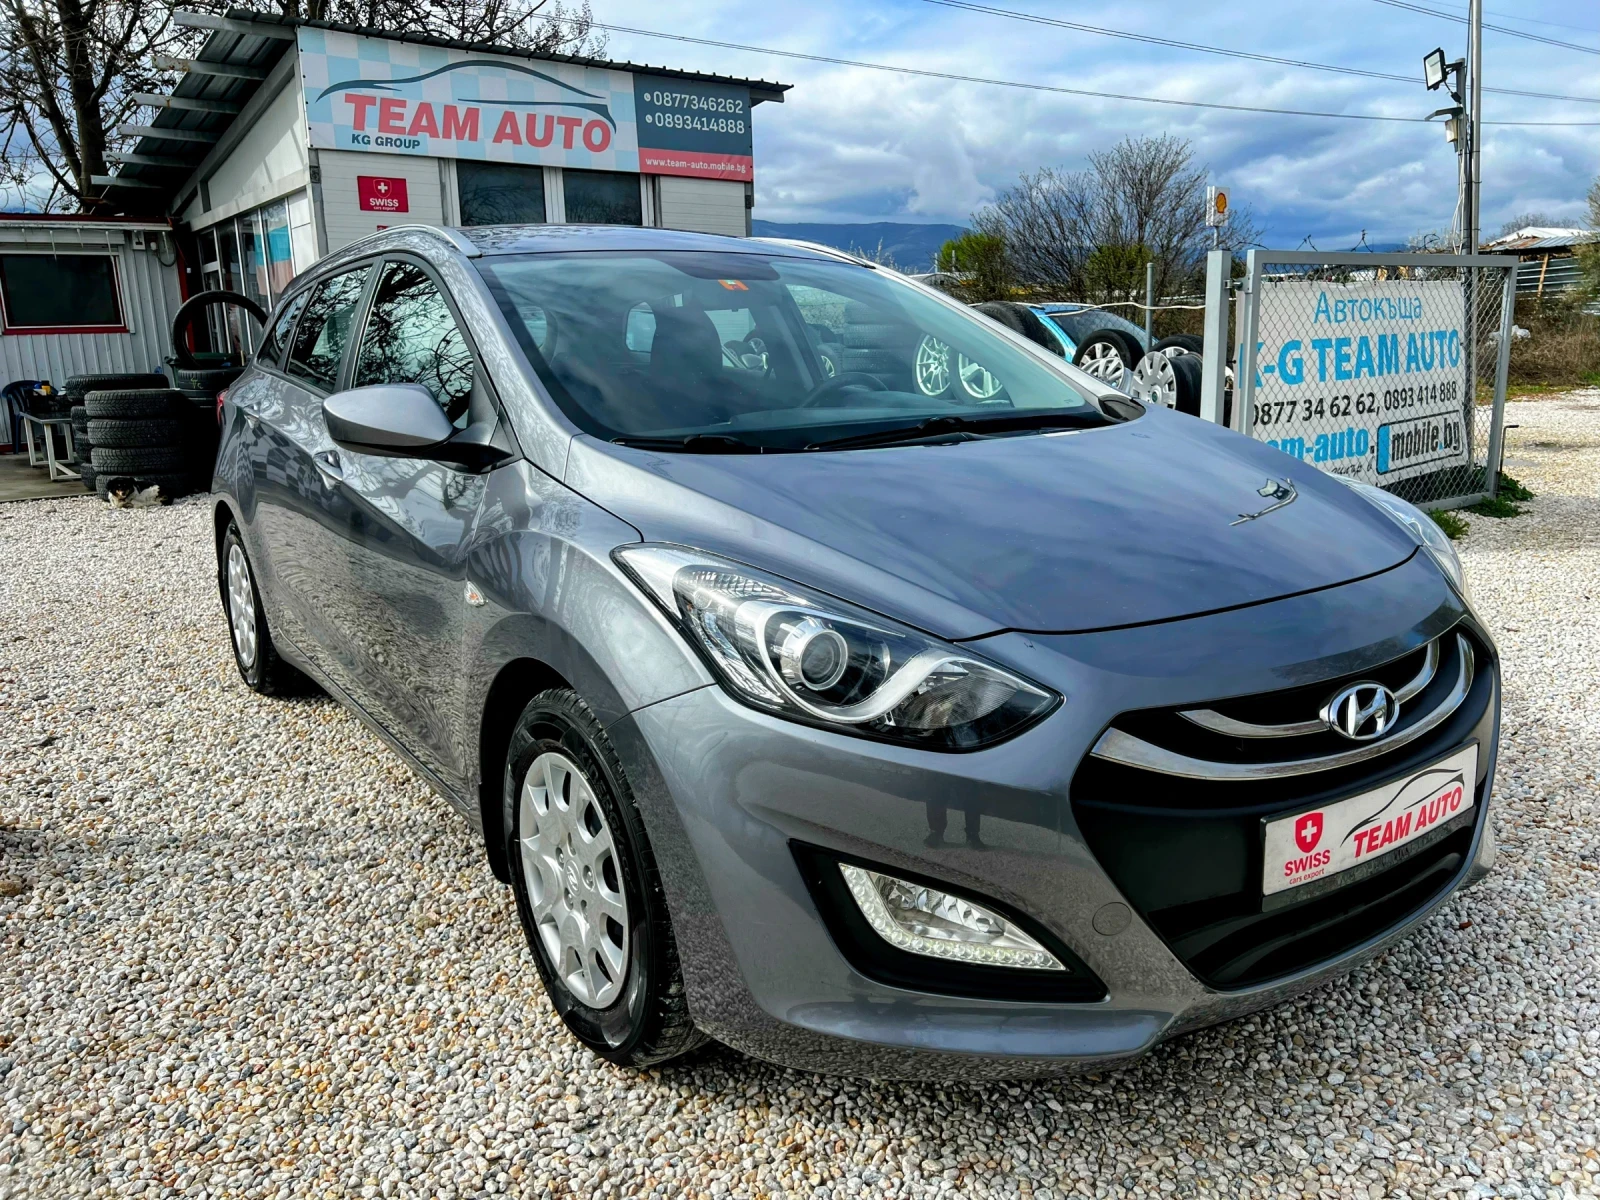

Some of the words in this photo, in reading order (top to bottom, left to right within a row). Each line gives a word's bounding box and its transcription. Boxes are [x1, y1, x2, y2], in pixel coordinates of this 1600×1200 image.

[653, 91, 743, 113] 0877346262
[344, 93, 480, 142] TEAM
[492, 110, 611, 153] AUTO
[655, 112, 745, 134] 0893414888
[351, 133, 371, 146] KG
[374, 136, 421, 149] GROUP
[645, 158, 746, 174] www.team-auto.mobile.bg
[369, 197, 399, 207] SWISS
[1313, 291, 1423, 324] Автокъща
[1311, 333, 1400, 383] TEAM
[1405, 328, 1460, 374] AUTO
[1302, 398, 1325, 421] 34
[1329, 395, 1351, 418] 62
[1355, 392, 1381, 416] 62,
[1384, 388, 1414, 411] 0893
[1417, 383, 1438, 405] 414
[1439, 380, 1458, 402] 888
[1391, 417, 1461, 462] mobile.bg
[1353, 811, 1413, 858] TEAM
[1414, 786, 1463, 832] AUTO
[1284, 849, 1331, 877] SWISS
[1289, 875, 1303, 885] cars
[1303, 867, 1325, 883] export
